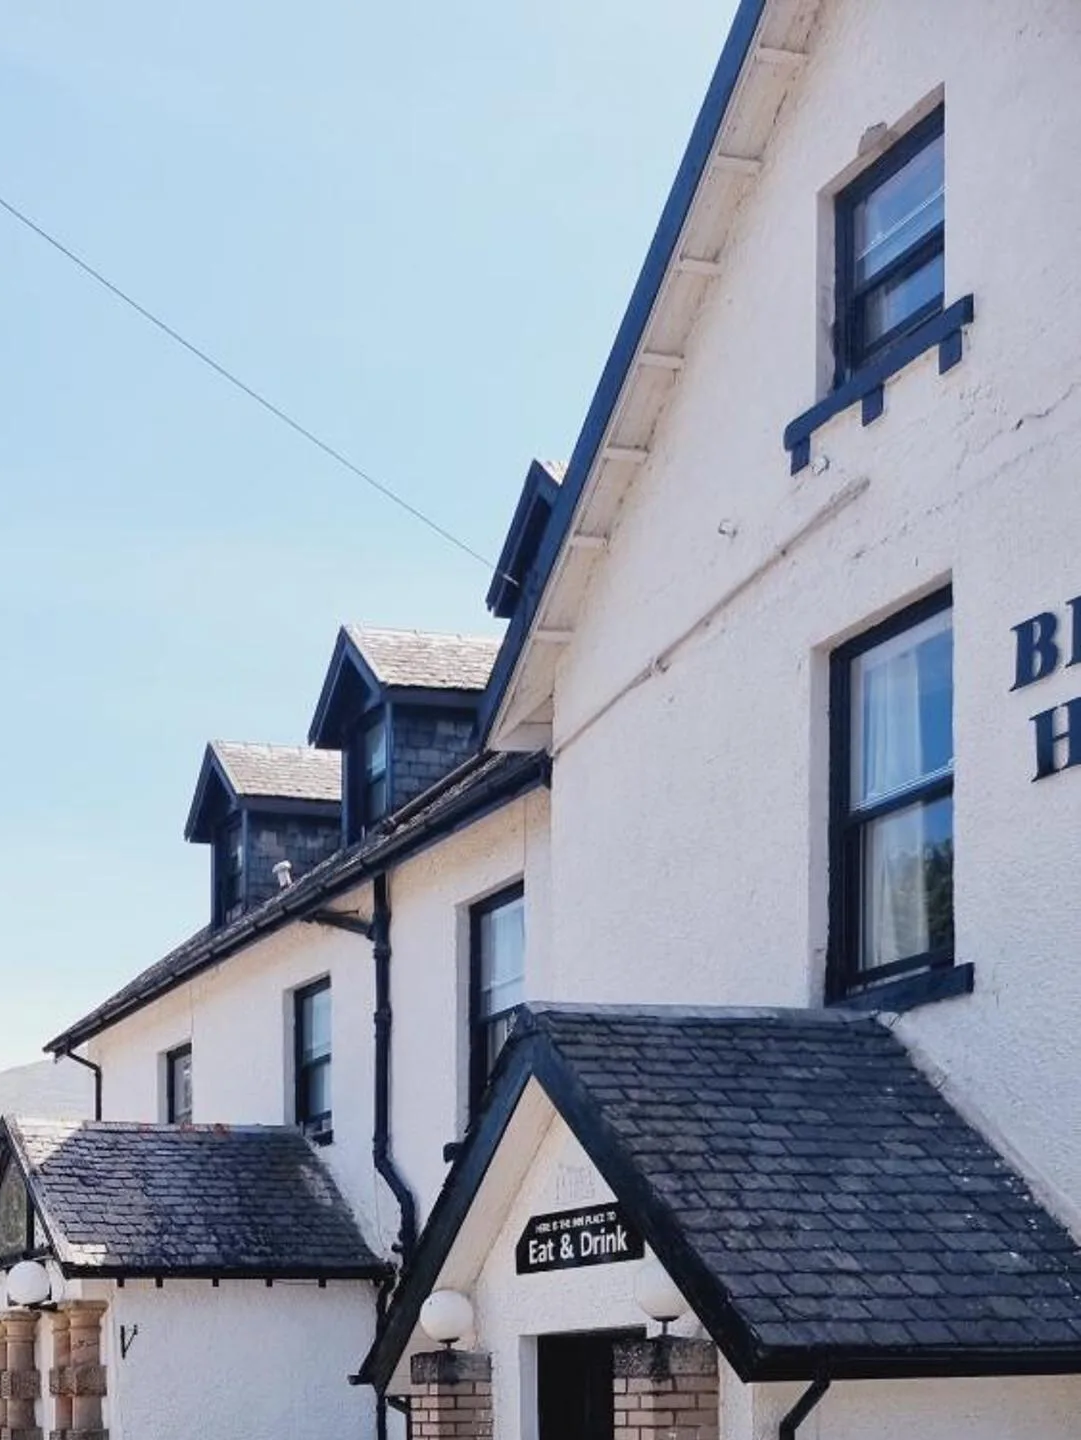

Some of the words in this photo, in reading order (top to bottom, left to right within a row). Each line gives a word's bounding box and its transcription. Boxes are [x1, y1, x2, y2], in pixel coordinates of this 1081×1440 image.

[528, 1238, 555, 1265] Eat
[560, 1232, 575, 1260] &
[580, 1225, 628, 1257] Drink
